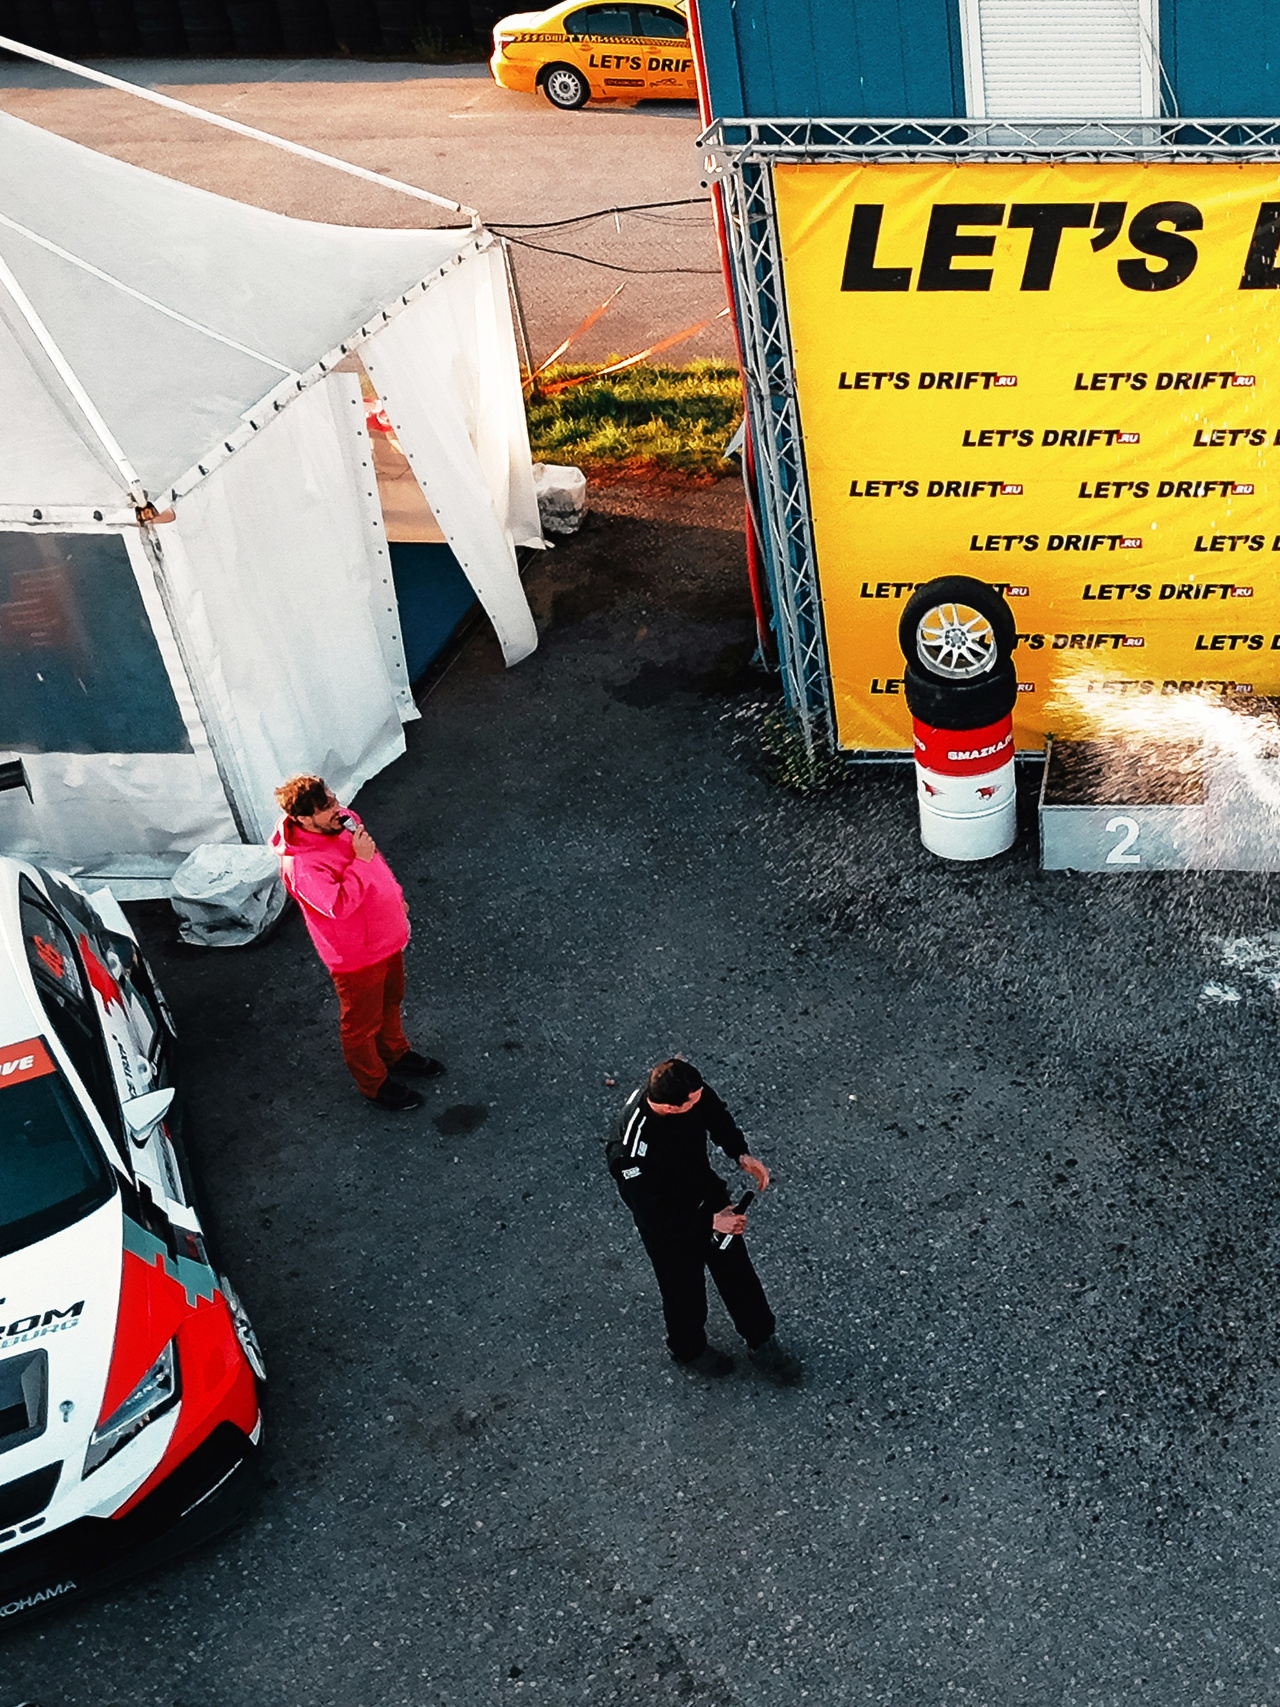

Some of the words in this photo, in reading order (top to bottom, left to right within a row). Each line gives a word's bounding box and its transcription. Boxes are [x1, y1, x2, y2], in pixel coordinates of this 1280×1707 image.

[589, 53, 642, 70] LET'S
[648, 57, 693, 73] DRIF
[841, 201, 1203, 291] LET'S
[839, 372, 909, 389] LET'S
[1075, 373, 1147, 390] LET'S
[963, 430, 1033, 447] LET'S
[1194, 429, 1266, 446] LET'S
[850, 481, 918, 497] LET'S
[1079, 482, 1149, 498] LET'S
[970, 535, 1039, 551] LET'S
[1194, 535, 1265, 551] LET'S
[1083, 584, 1151, 600] LET'S
[1195, 635, 1264, 650] LET'S
[1105, 817, 1140, 864] 2
